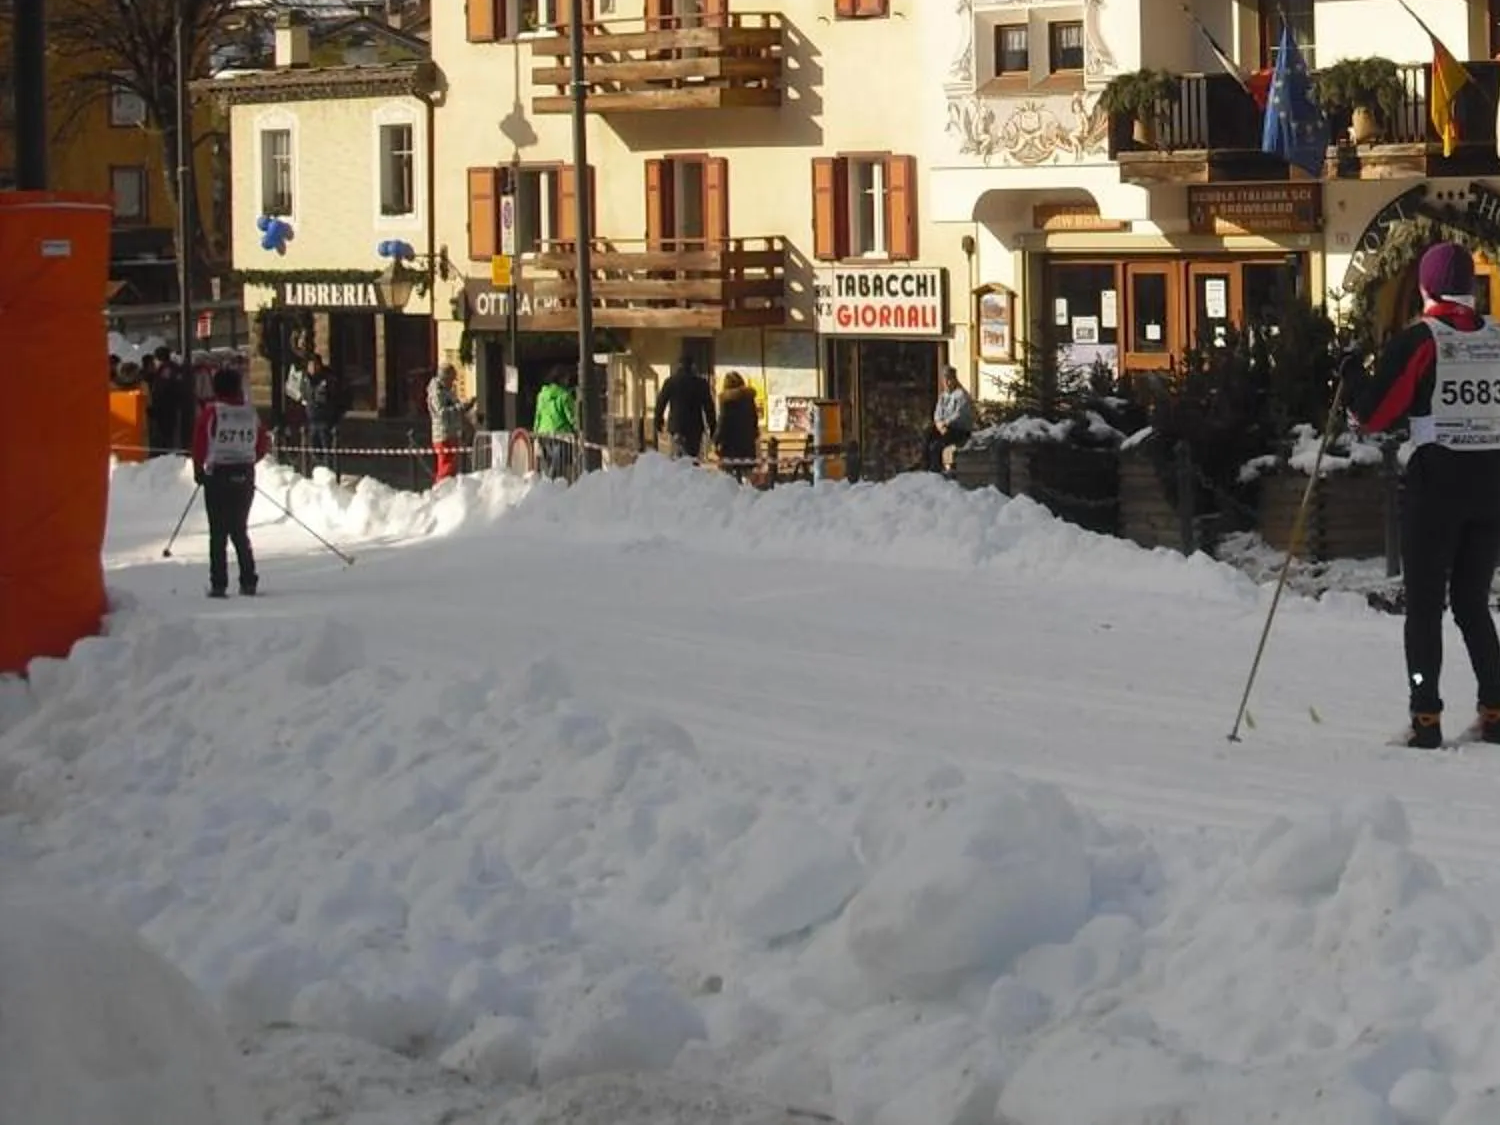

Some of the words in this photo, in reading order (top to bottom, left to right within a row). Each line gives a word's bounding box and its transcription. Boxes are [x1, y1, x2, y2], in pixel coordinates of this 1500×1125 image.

[284, 282, 379, 307] LIBRERIA
[836, 274, 937, 297] TABACCHI
[476, 291, 533, 316] OTTIA
[836, 305, 937, 328] GIORNALI
